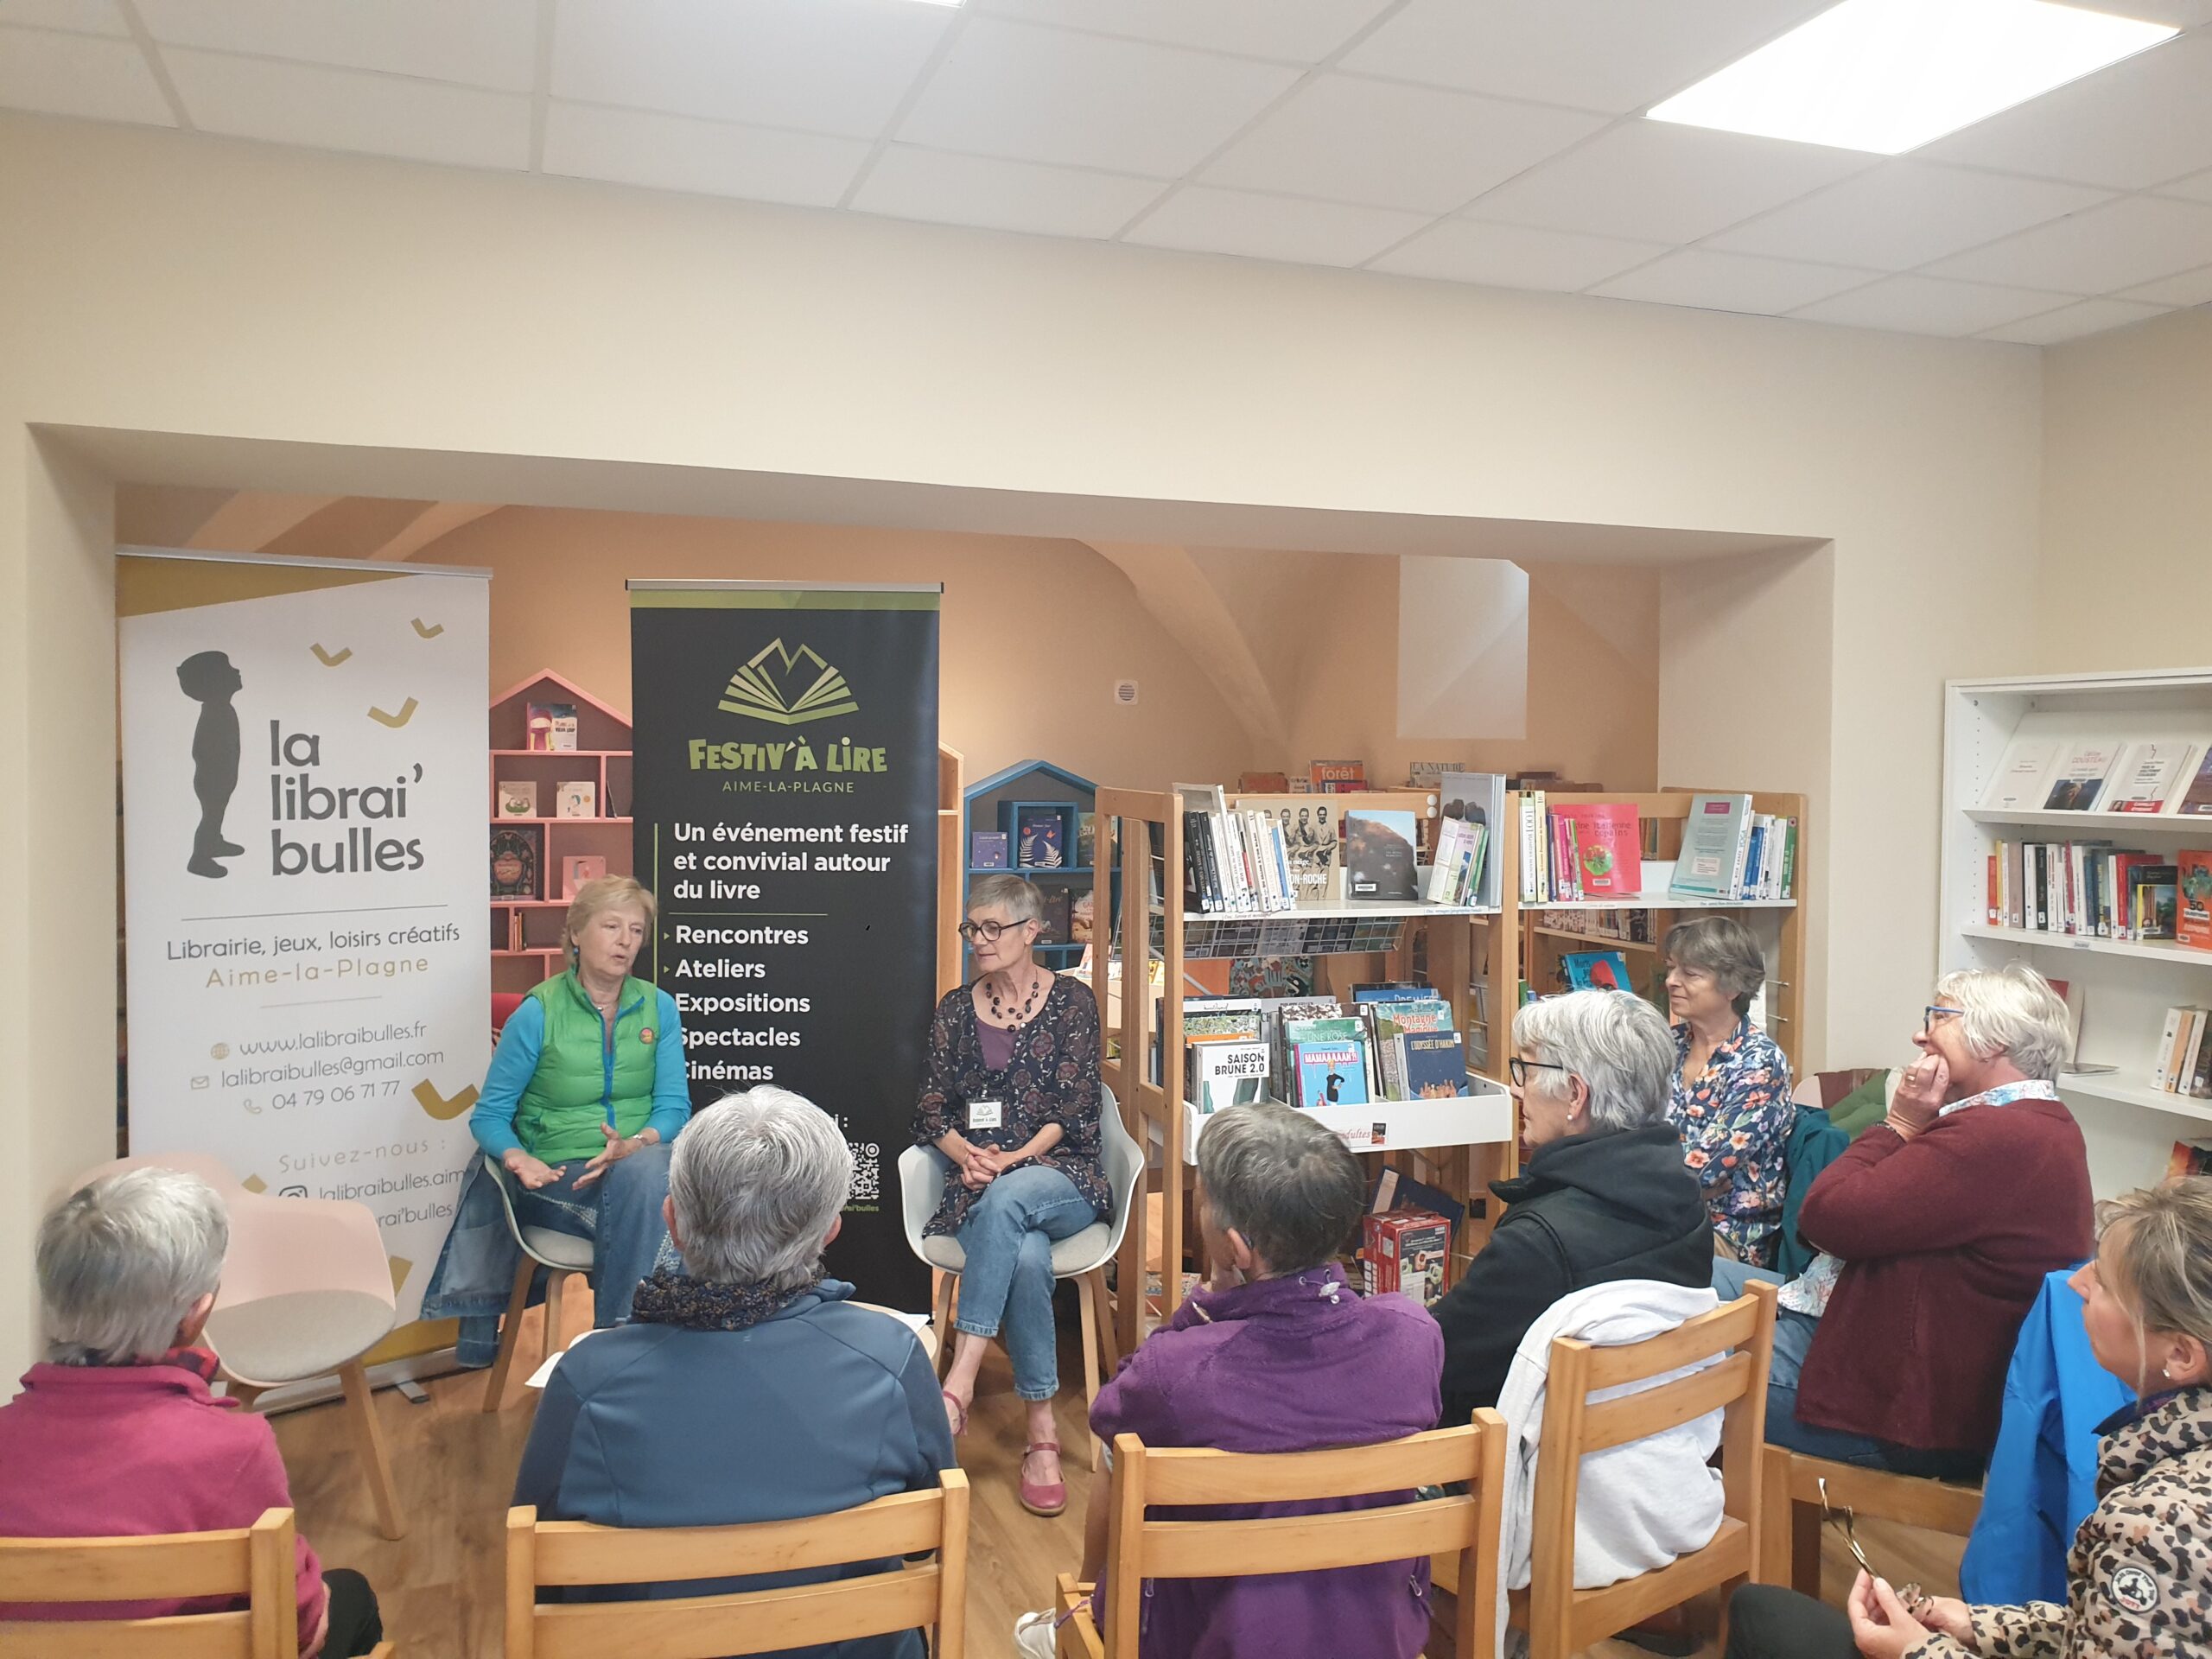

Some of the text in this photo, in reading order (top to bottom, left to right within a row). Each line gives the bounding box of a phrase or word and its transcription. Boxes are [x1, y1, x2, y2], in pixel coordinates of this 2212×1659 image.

[270, 719, 321, 766] la
[270, 762, 423, 821] librai'
[721, 780, 855, 793] AIME-LA-PLAGNE
[673, 822, 908, 843] Un événement festif
[270, 827, 425, 876] bulles
[673, 852, 890, 872] et convivial autour
[673, 880, 761, 899] du livre
[1290, 874, 1327, 885] ON-ROCHE
[167, 923, 461, 961] Librairie, jeux, loisirs créatifs
[675, 925, 809, 945] Rencontres
[206, 957, 429, 988] Aime-la-Plagne
[675, 958, 766, 979] Ateliers
[675, 993, 811, 1016] Expositions
[1393, 1014, 1438, 1027] Montagne
[239, 1020, 428, 1056] www.lalibraibulles.fr
[1328, 1031, 1348, 1041] ROSE
[221, 1050, 444, 1088] lalibraibulles@gmail.com
[1214, 1062, 1265, 1075] BRUNE 2.0
[1227, 1052, 1265, 1064] SAISON
[271, 1080, 401, 1110] 04 79 06 71 77
[278, 1140, 430, 1174] Suivez-nous
[376, 1202, 454, 1229] rai'bulles
